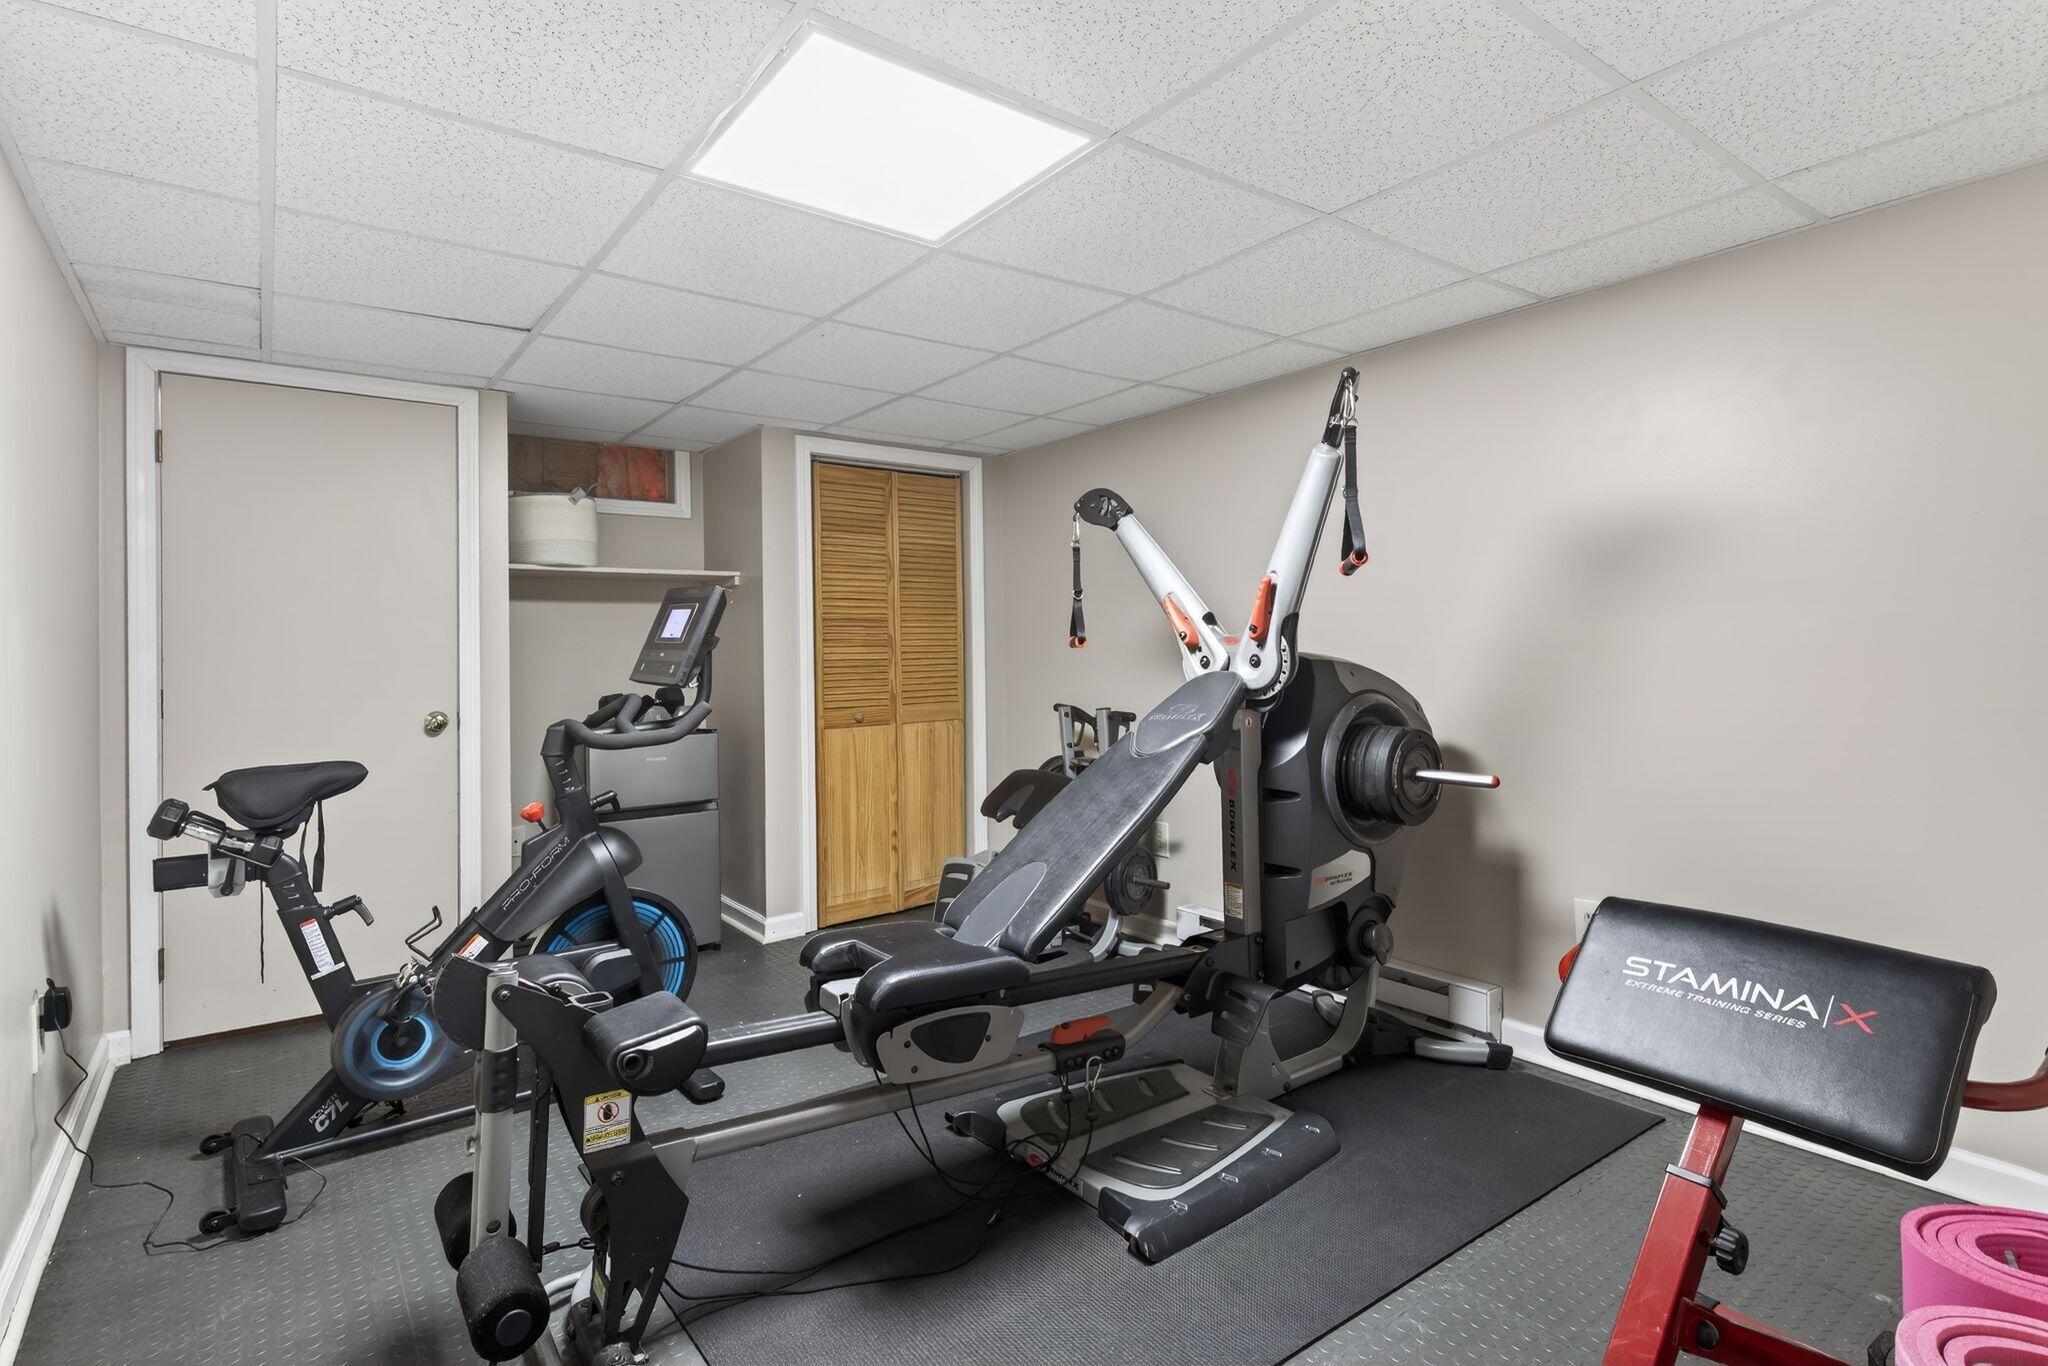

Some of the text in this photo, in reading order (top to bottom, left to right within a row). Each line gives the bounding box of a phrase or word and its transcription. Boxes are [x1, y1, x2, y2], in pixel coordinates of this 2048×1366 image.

[1228, 798, 1237, 872] BOWFLEX
[501, 836, 570, 911] PRO-FORM
[1622, 956, 1820, 1020] STAMINA
[1624, 978, 1807, 1030] EXTREME TRAINING SERIES
[314, 1099, 349, 1132] C7L
